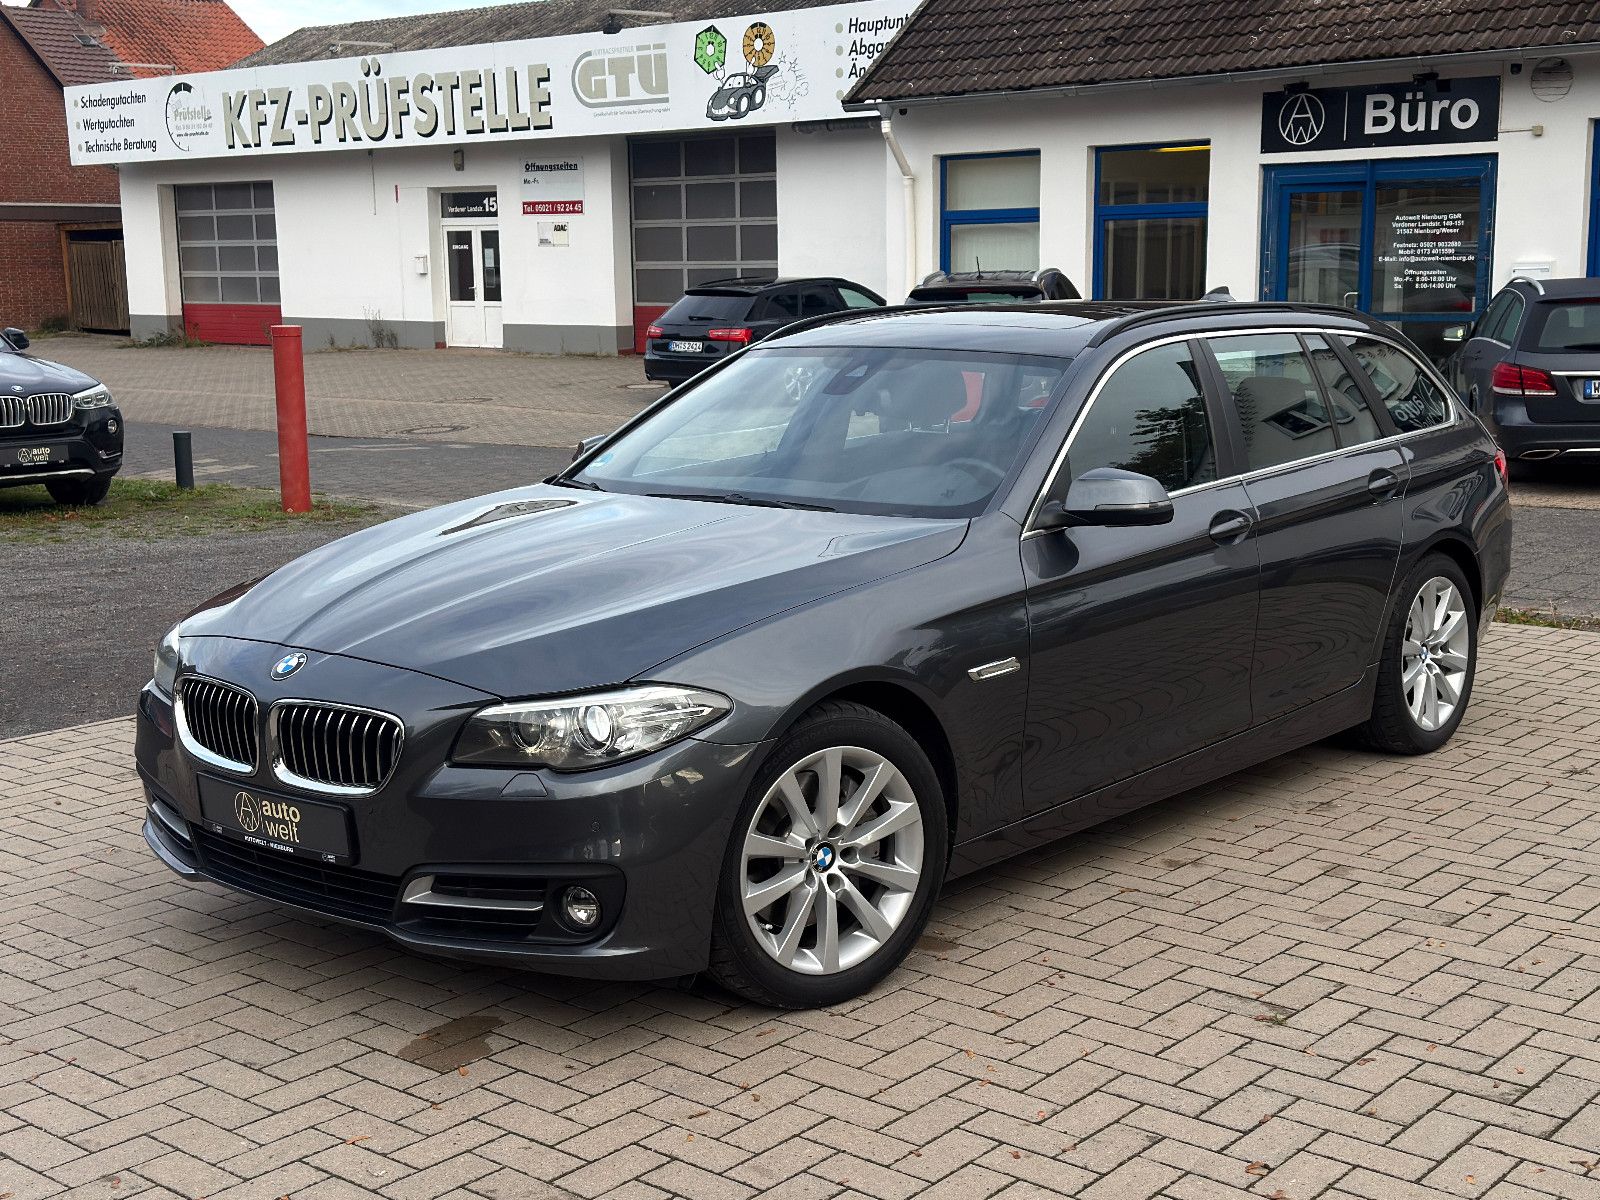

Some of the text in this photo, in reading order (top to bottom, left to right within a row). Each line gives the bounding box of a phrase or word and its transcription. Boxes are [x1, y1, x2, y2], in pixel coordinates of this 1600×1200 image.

[848, 38, 890, 59] Abga
[578, 43, 669, 100] GTÜ
[80, 90, 146, 110] Schadengutachten
[222, 57, 552, 149] KFZ-PRÜFSTELLE
[174, 105, 211, 121] Prüfstelle
[1364, 92, 1480, 134] Büro
[83, 117, 135, 132] Wertgutachten
[84, 137, 157, 153] Technische Beratung
[525, 161, 578, 172] Öffnungszeiten
[484, 197, 497, 212] 15
[262, 800, 300, 823] auto
[266, 820, 299, 842] welt
